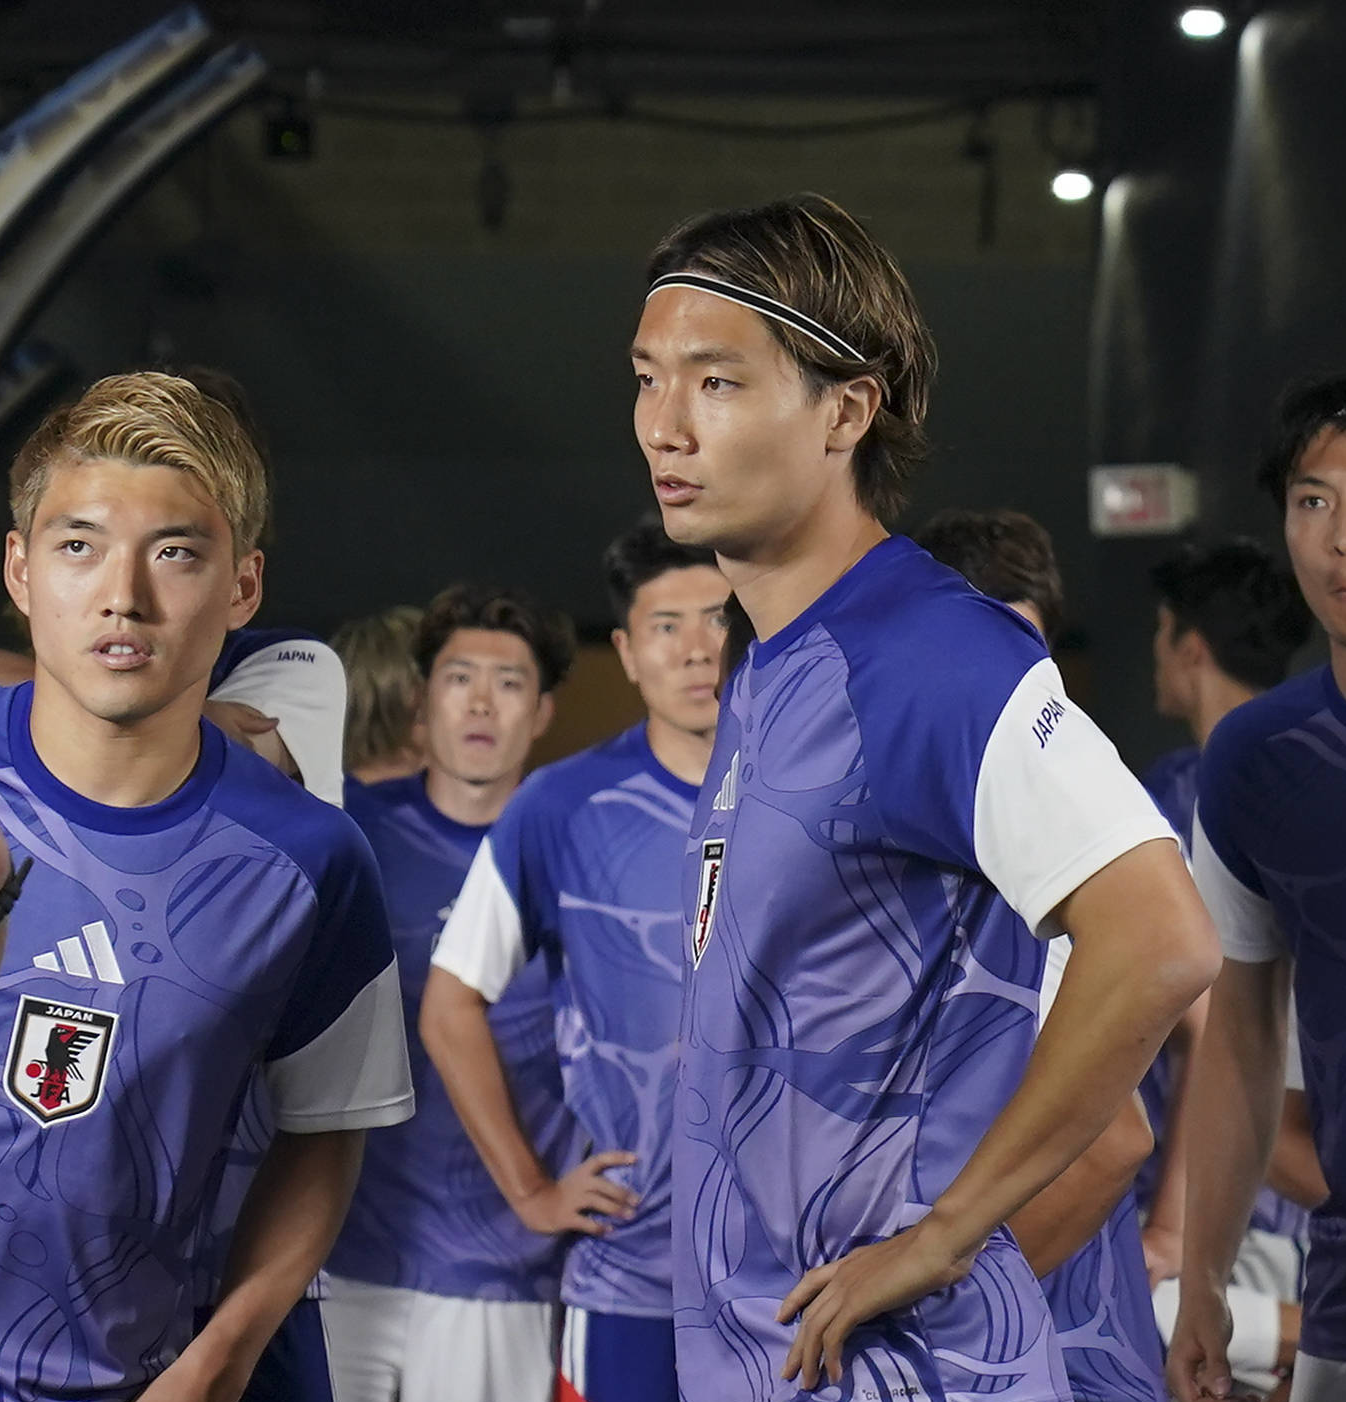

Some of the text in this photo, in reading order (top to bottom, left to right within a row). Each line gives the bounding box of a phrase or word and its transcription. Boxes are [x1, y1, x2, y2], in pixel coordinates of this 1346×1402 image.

[277, 650, 315, 664] JAPAN
[1031, 696, 1066, 749] JAPAN
[45, 1005, 94, 1023] JAPAN
[29, 1081, 72, 1104] JFA
